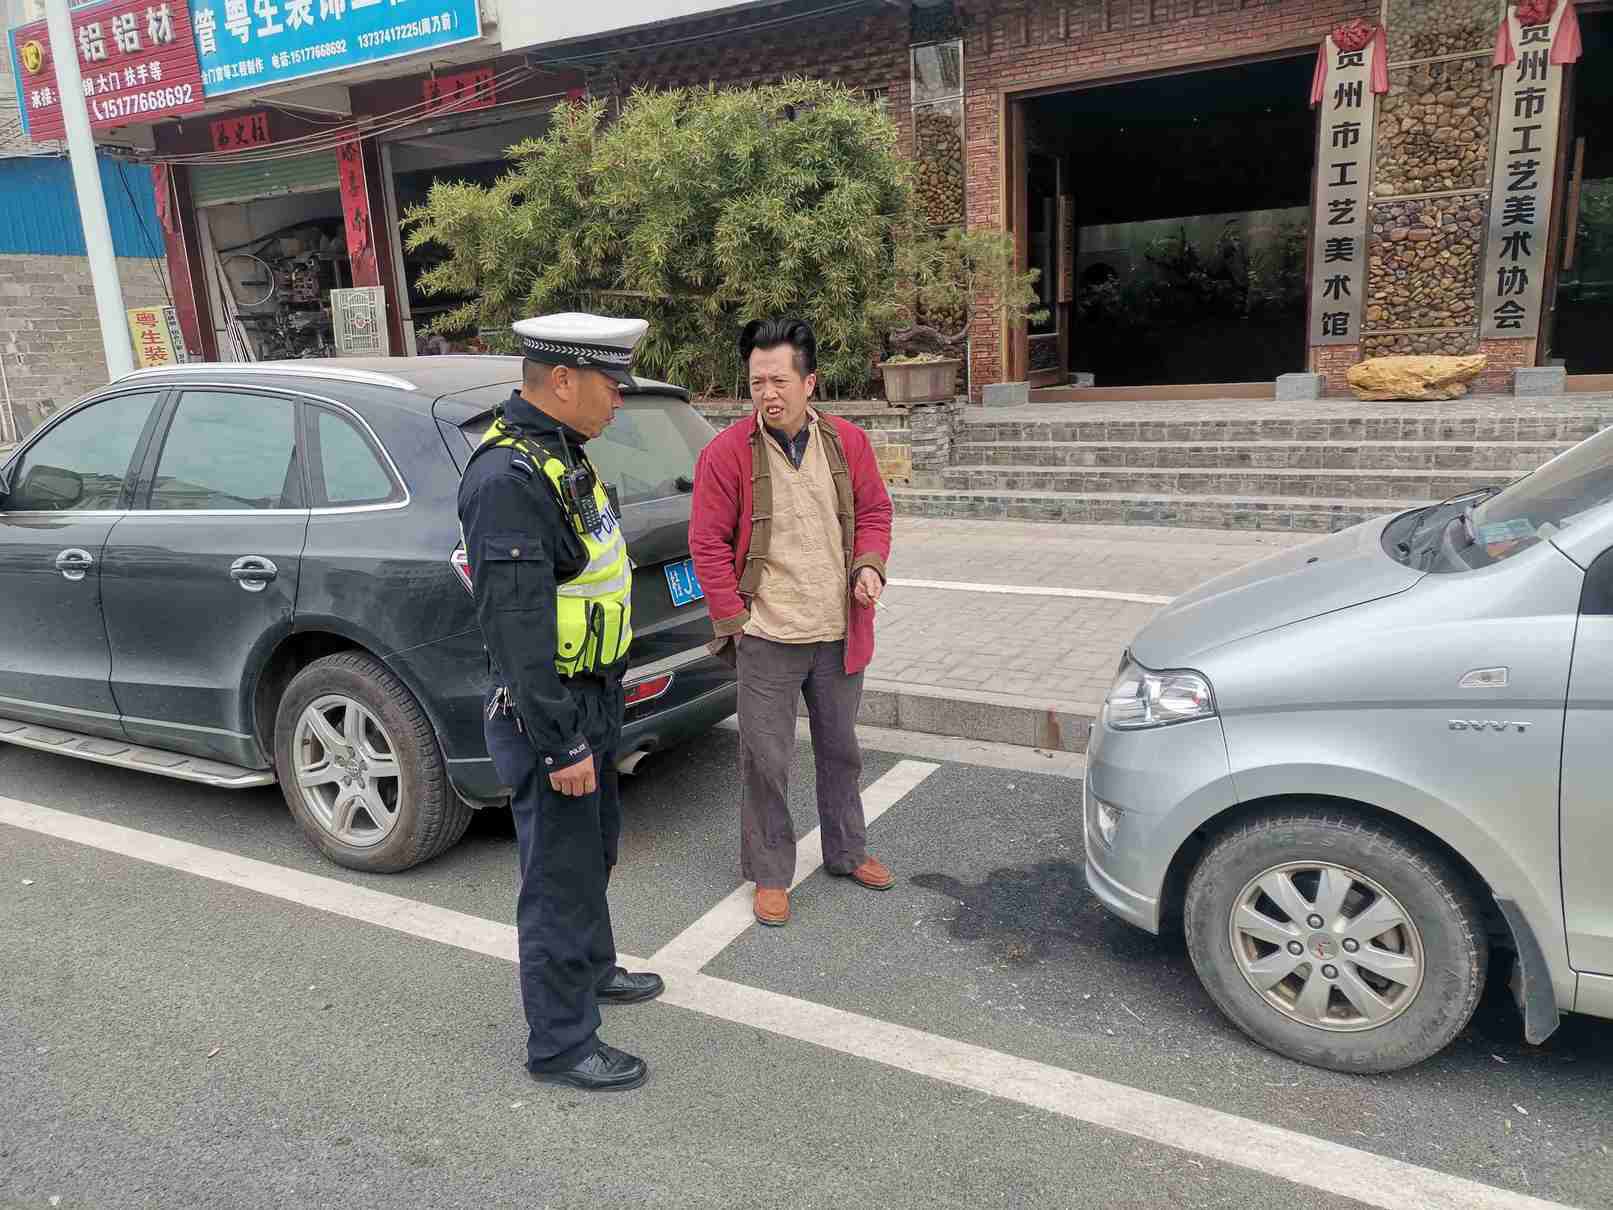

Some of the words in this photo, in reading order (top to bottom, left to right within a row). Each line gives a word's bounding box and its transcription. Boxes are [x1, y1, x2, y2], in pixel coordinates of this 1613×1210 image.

[102, 83, 194, 118] 15177668692
[135, 311, 169, 368] 粤生装
